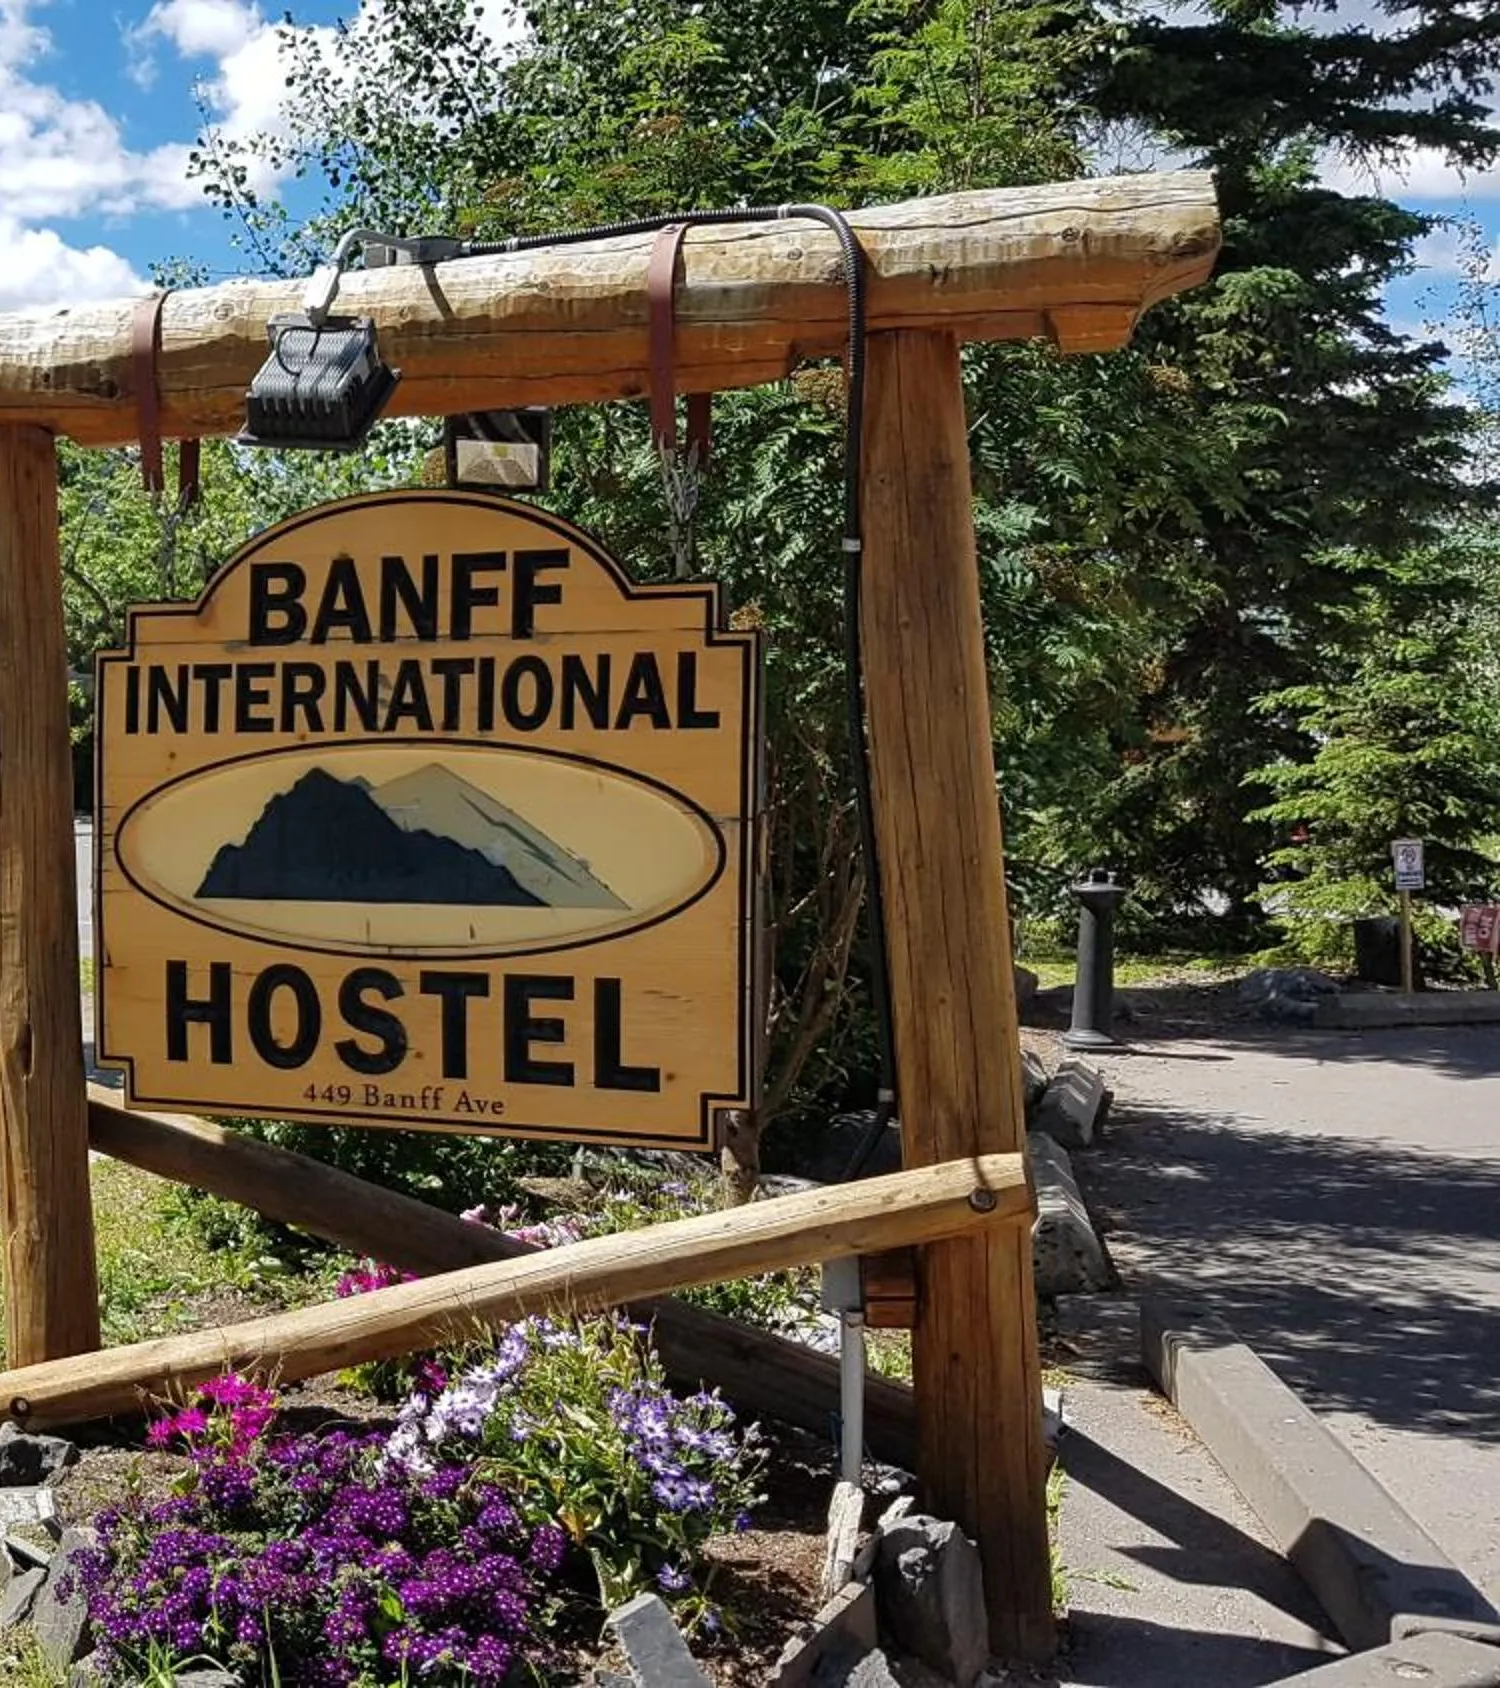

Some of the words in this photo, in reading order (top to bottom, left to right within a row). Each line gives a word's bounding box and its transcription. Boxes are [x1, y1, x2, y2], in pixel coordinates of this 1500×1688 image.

[249, 548, 570, 646] BANFF
[124, 651, 720, 734] INTERNATIONAL
[166, 960, 661, 1092] HOSTEL
[302, 1083, 351, 1106] 449
[362, 1083, 444, 1110] Banff
[453, 1090, 505, 1115] Ave
